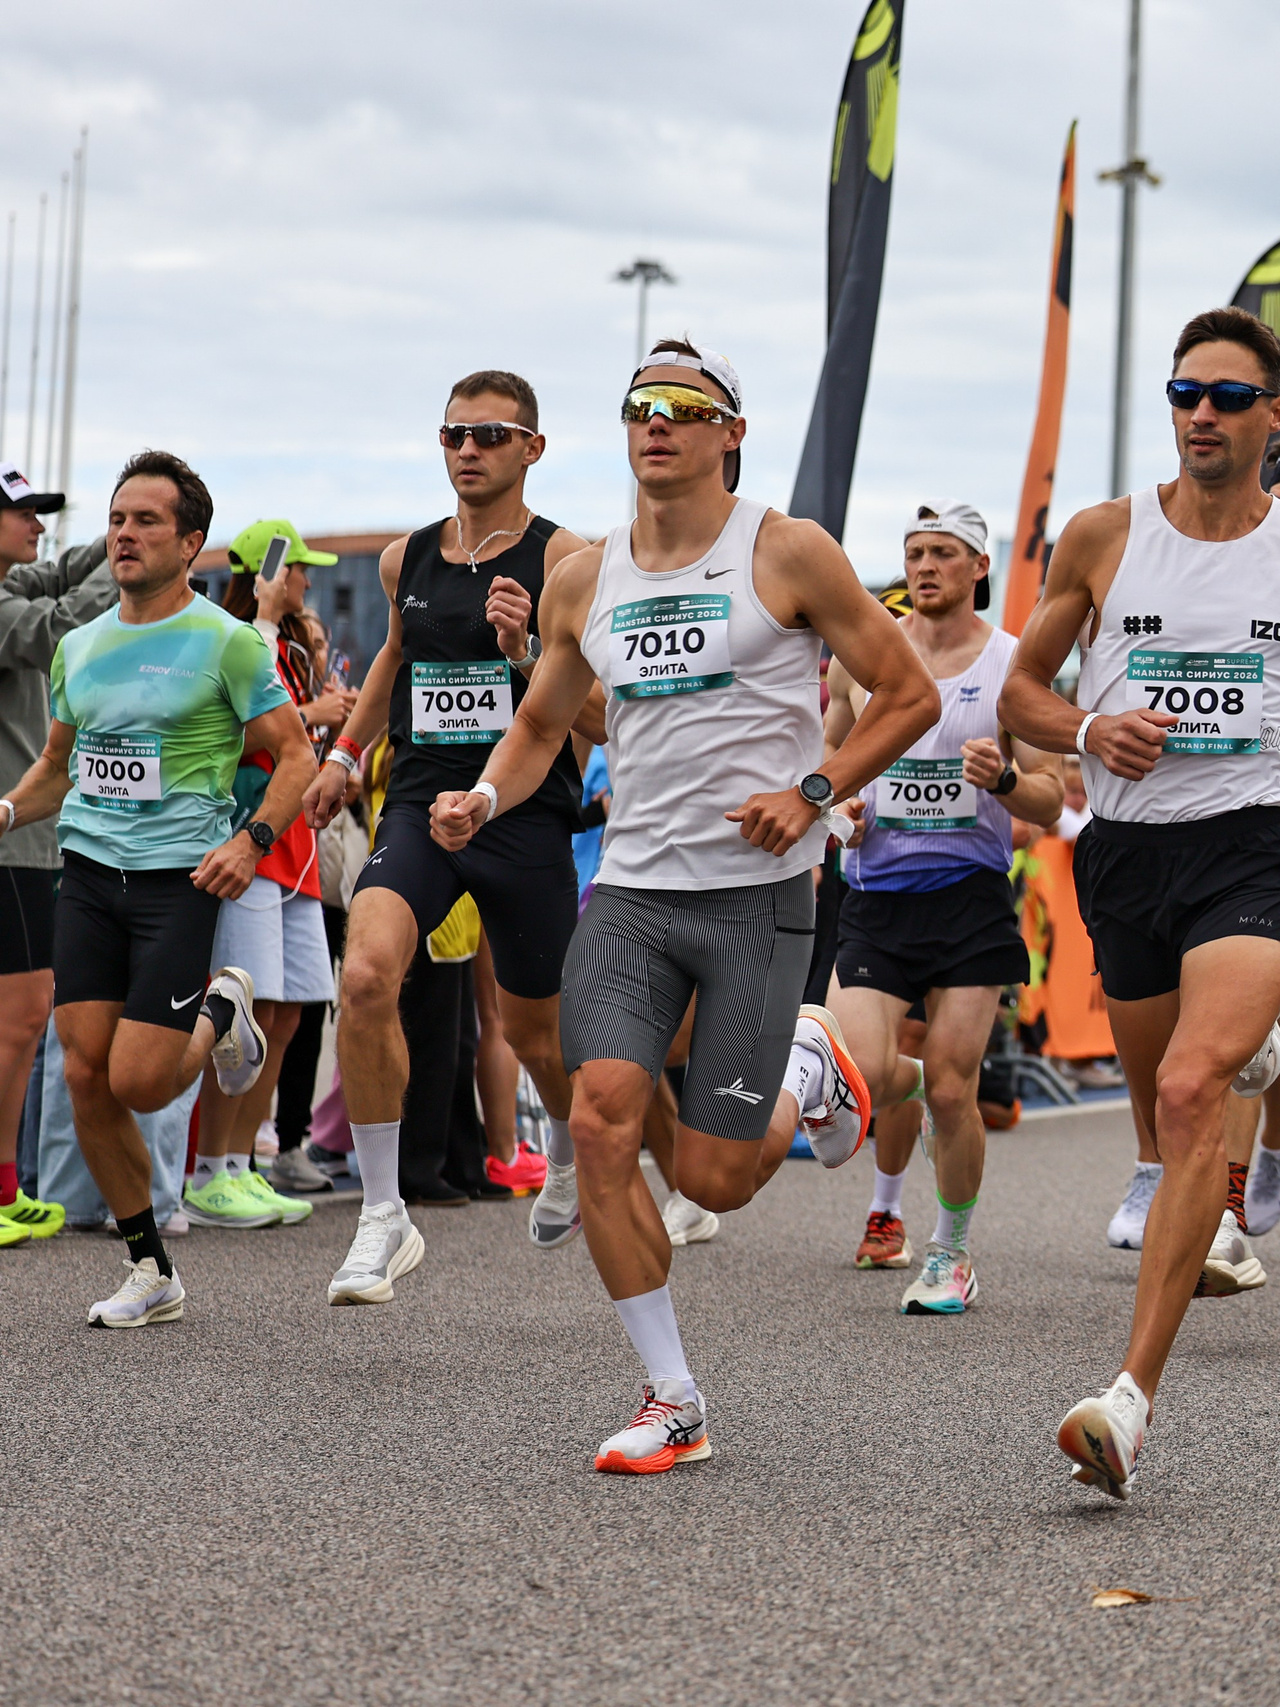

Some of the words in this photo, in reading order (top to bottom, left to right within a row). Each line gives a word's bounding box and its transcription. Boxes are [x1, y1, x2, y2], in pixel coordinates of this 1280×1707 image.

[614, 617, 652, 629] MANSTAR
[654, 611, 694, 623] СИРИУС
[697, 610, 723, 618] 2026
[624, 627, 705, 661] 7010
[639, 663, 688, 677] ЭЛИТА
[1132, 669, 1183, 678] MANSTAR
[1186, 670, 1230, 679] СИРИУС
[1233, 672, 1258, 680] 2026
[415, 677, 446, 685] MANSTAR
[448, 676, 482, 684] СИРИУС
[484, 675, 506, 683] 2026
[646, 684, 676, 692] GRAND
[677, 680, 705, 690] FINAL
[422, 689, 497, 713] 7004
[1144, 686, 1244, 715] 7008
[438, 718, 480, 729] ЭЛИТА
[1167, 721, 1221, 735] ЭЛИТА
[78, 743, 104, 753] MANSTAR
[105, 746, 133, 755] СИРИУС
[85, 757, 146, 782] 7000
[917, 771, 950, 779] СИРИУС
[98, 785, 130, 797] ЭЛИТА
[889, 781, 962, 803] 7009
[906, 807, 945, 816] ЭЛИТА
[1238, 915, 1274, 927] MOAX
